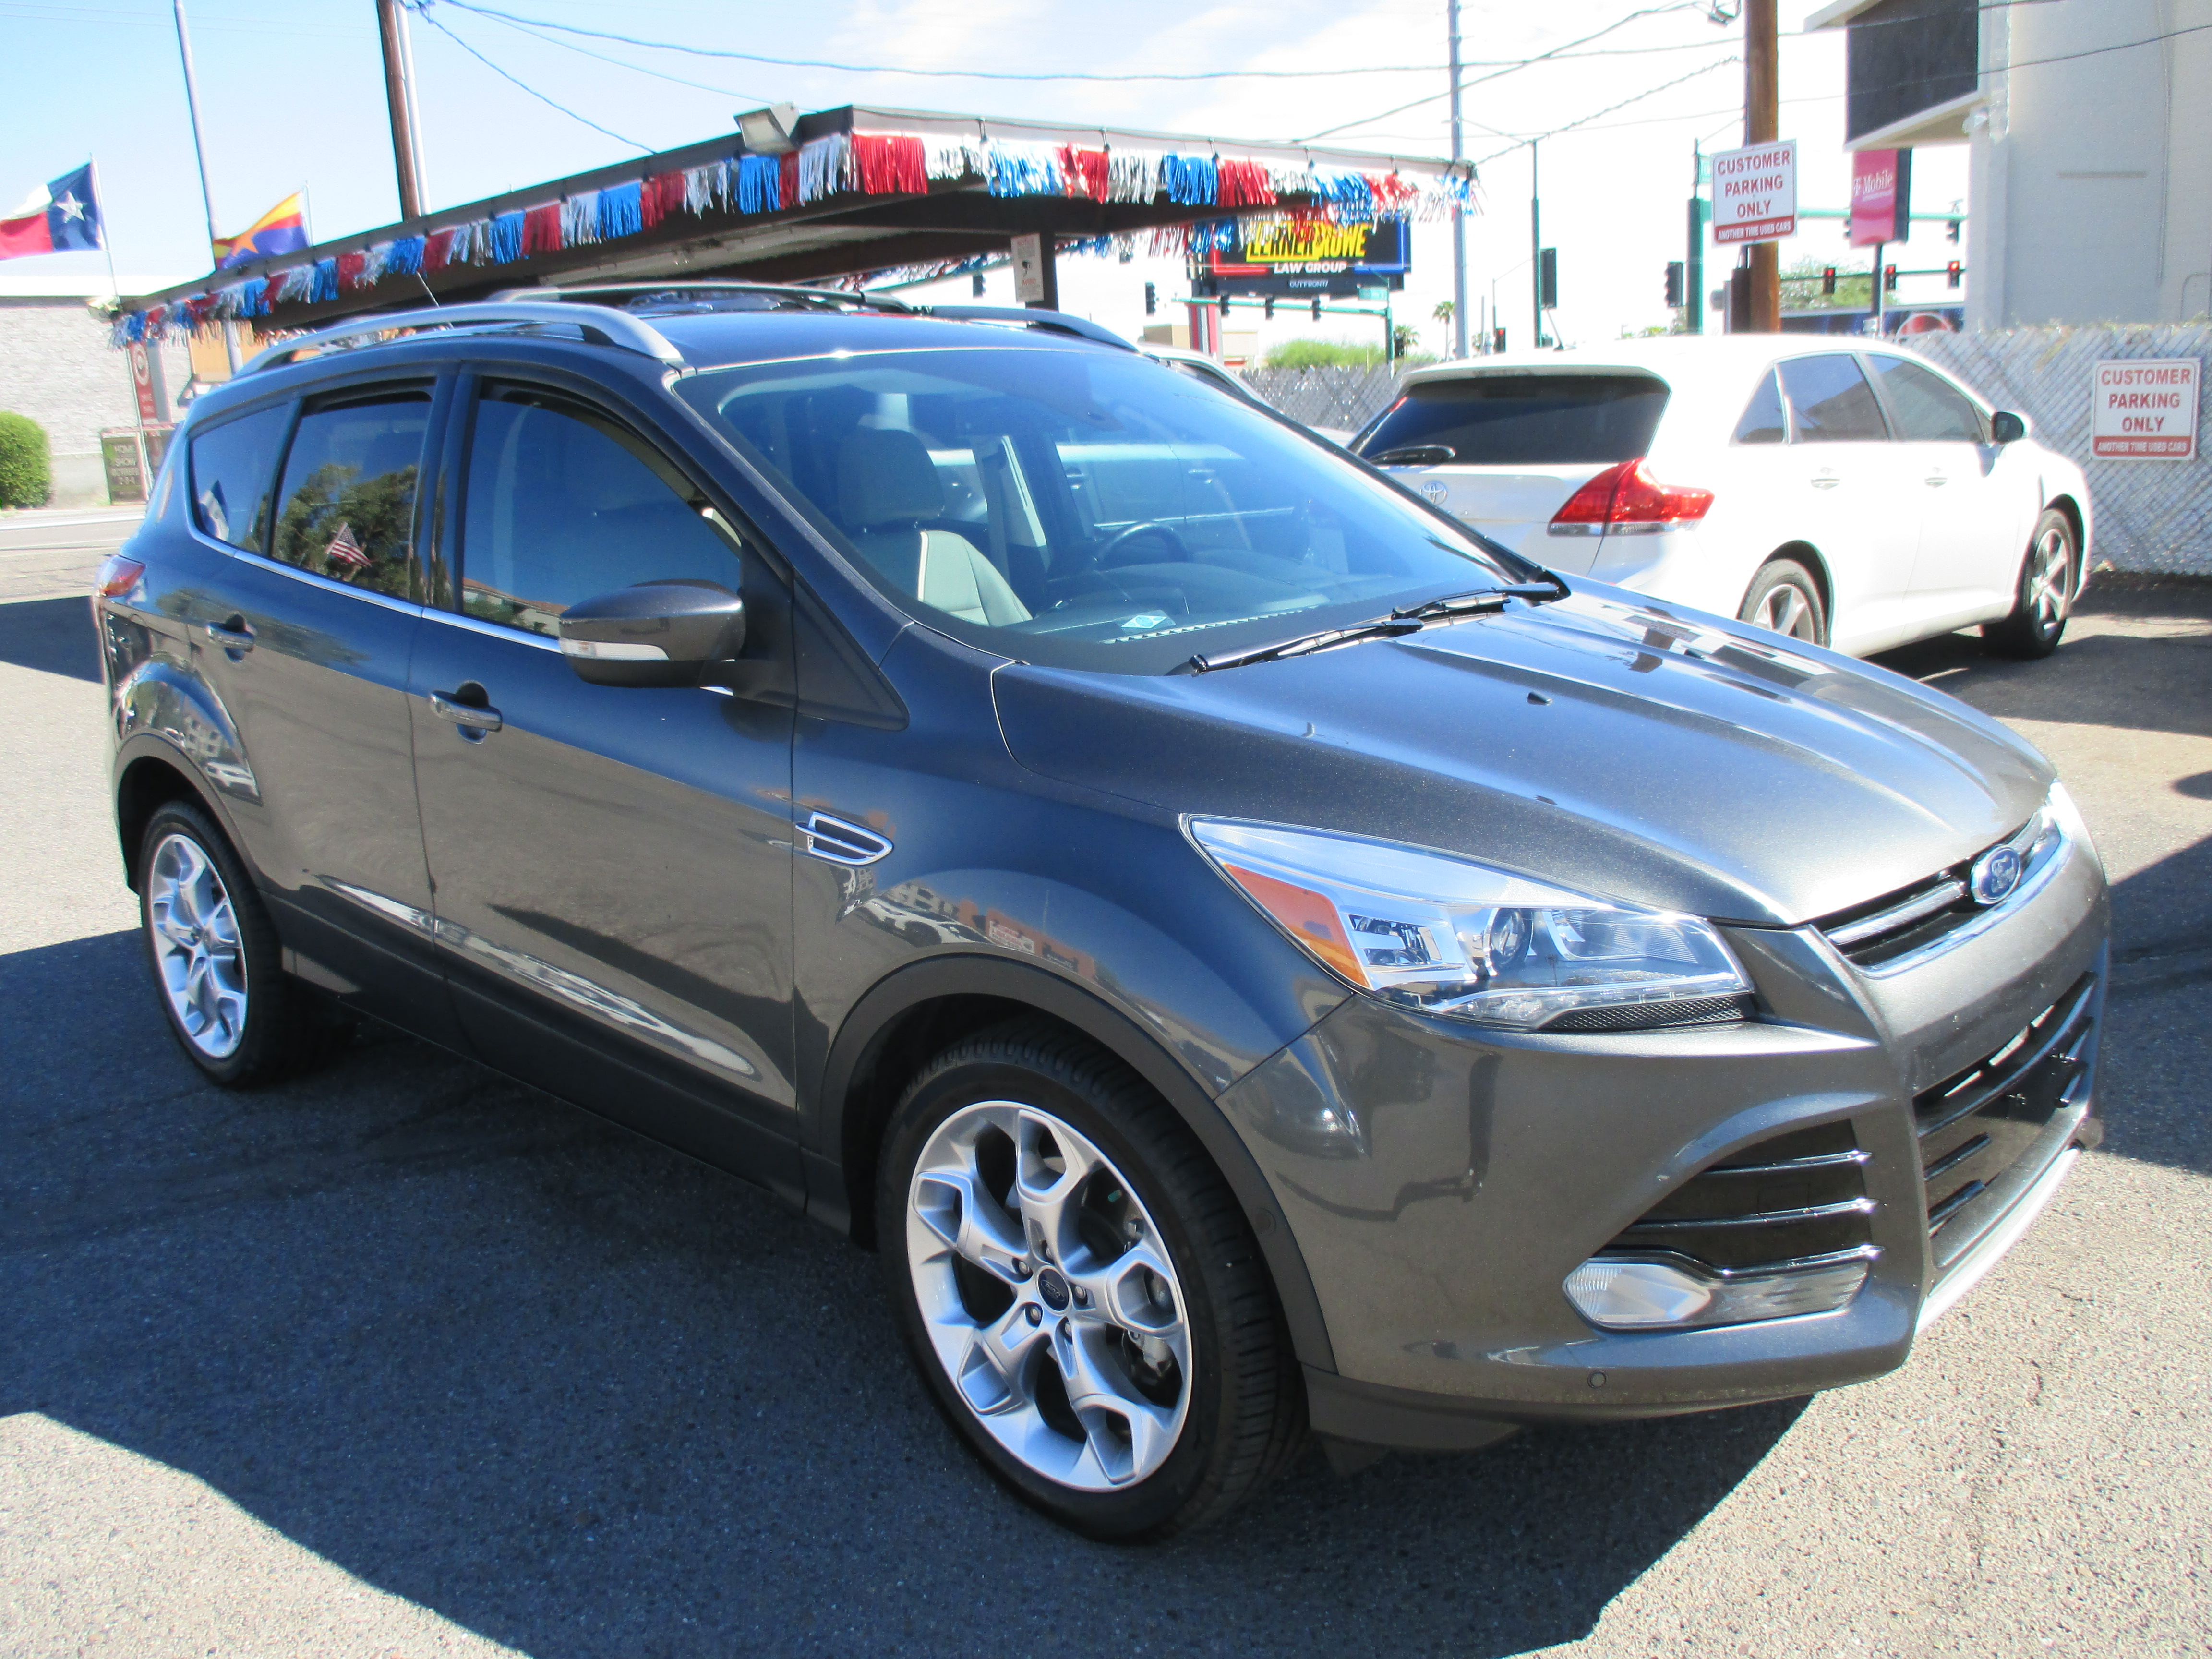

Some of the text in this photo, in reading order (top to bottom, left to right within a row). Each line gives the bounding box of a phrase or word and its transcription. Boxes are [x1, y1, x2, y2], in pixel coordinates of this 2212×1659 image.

[1717, 150, 1790, 176] CUSTOMER
[1724, 175, 1783, 198] PARKING
[1736, 199, 1771, 218] ONLY
[1776, 221, 1791, 232] CARS
[1274, 260, 1348, 274] LAW GROUP
[2101, 368, 2191, 385] CUSTOMER
[2108, 393, 2180, 409] PARKING
[2122, 417, 2164, 432] ONLY
